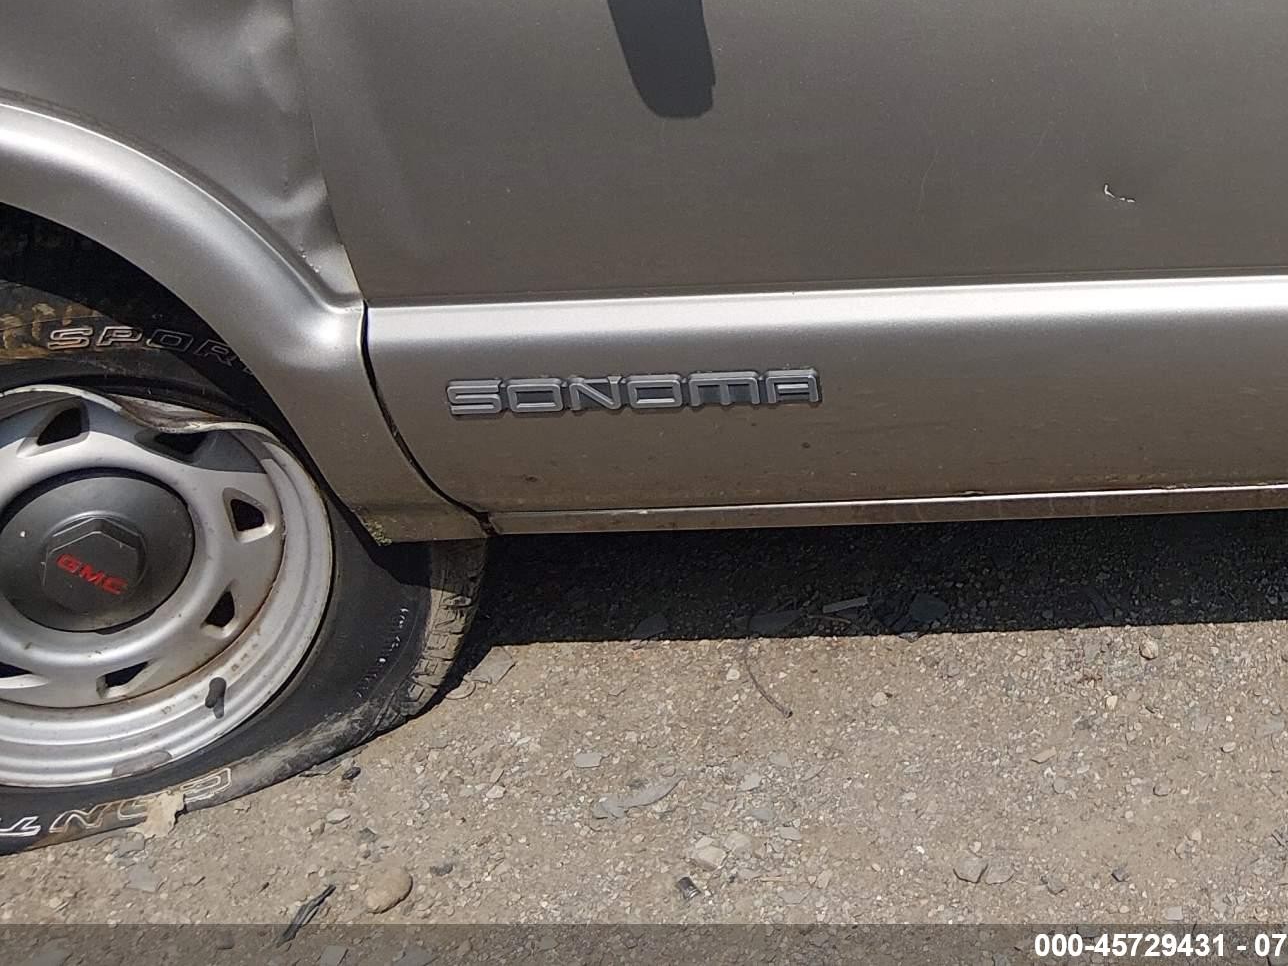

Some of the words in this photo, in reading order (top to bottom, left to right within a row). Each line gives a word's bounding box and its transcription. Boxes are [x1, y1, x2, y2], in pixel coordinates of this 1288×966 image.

[47, 326, 254, 376] SPOR
[446, 369, 823, 418] SONOMA
[56, 553, 129, 595] GMC
